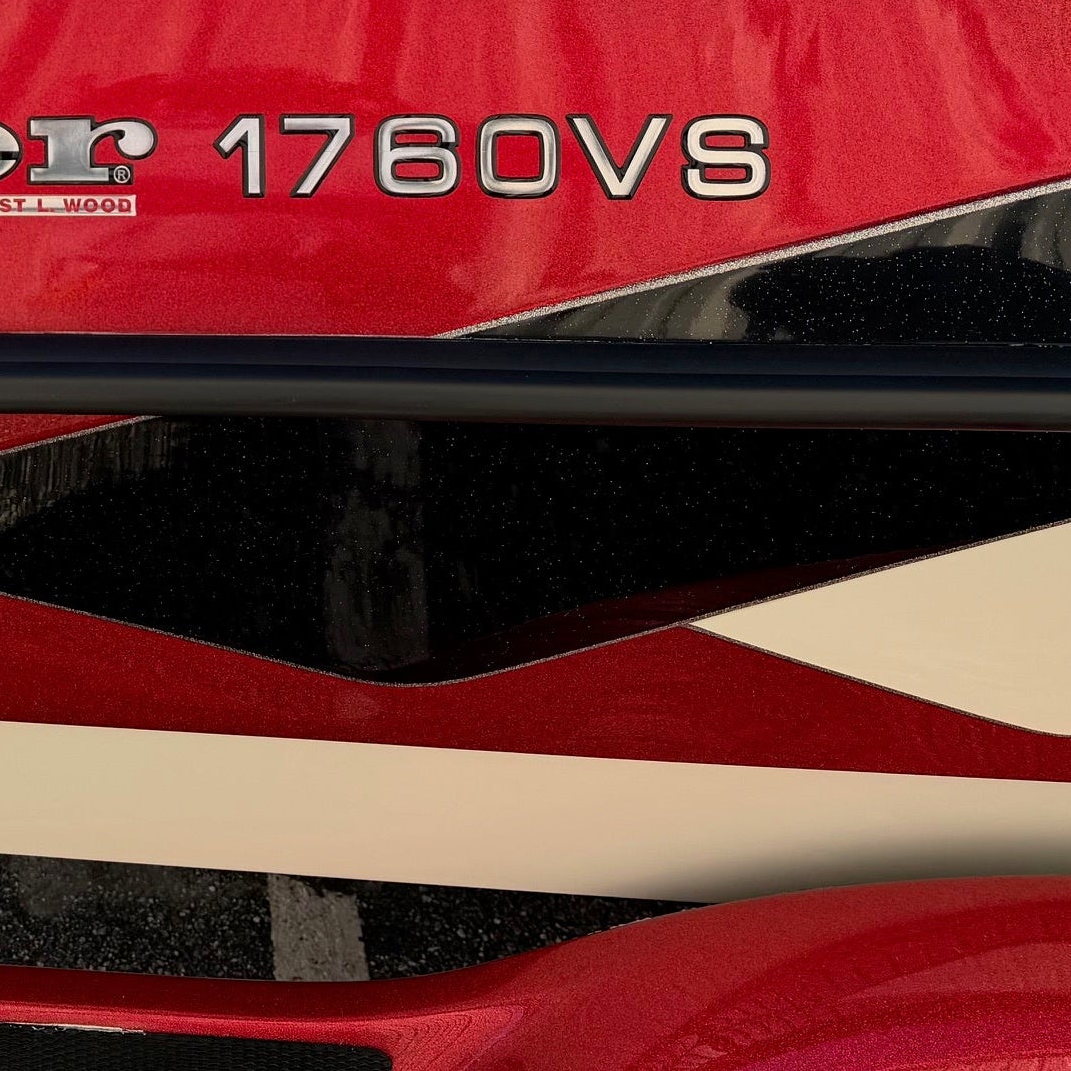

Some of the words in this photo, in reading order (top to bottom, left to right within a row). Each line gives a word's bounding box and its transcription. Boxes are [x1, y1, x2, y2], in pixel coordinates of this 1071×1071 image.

[213, 114, 771, 201] 1760VS
[38, 198, 55, 213] L.
[63, 198, 132, 213] WOOD
